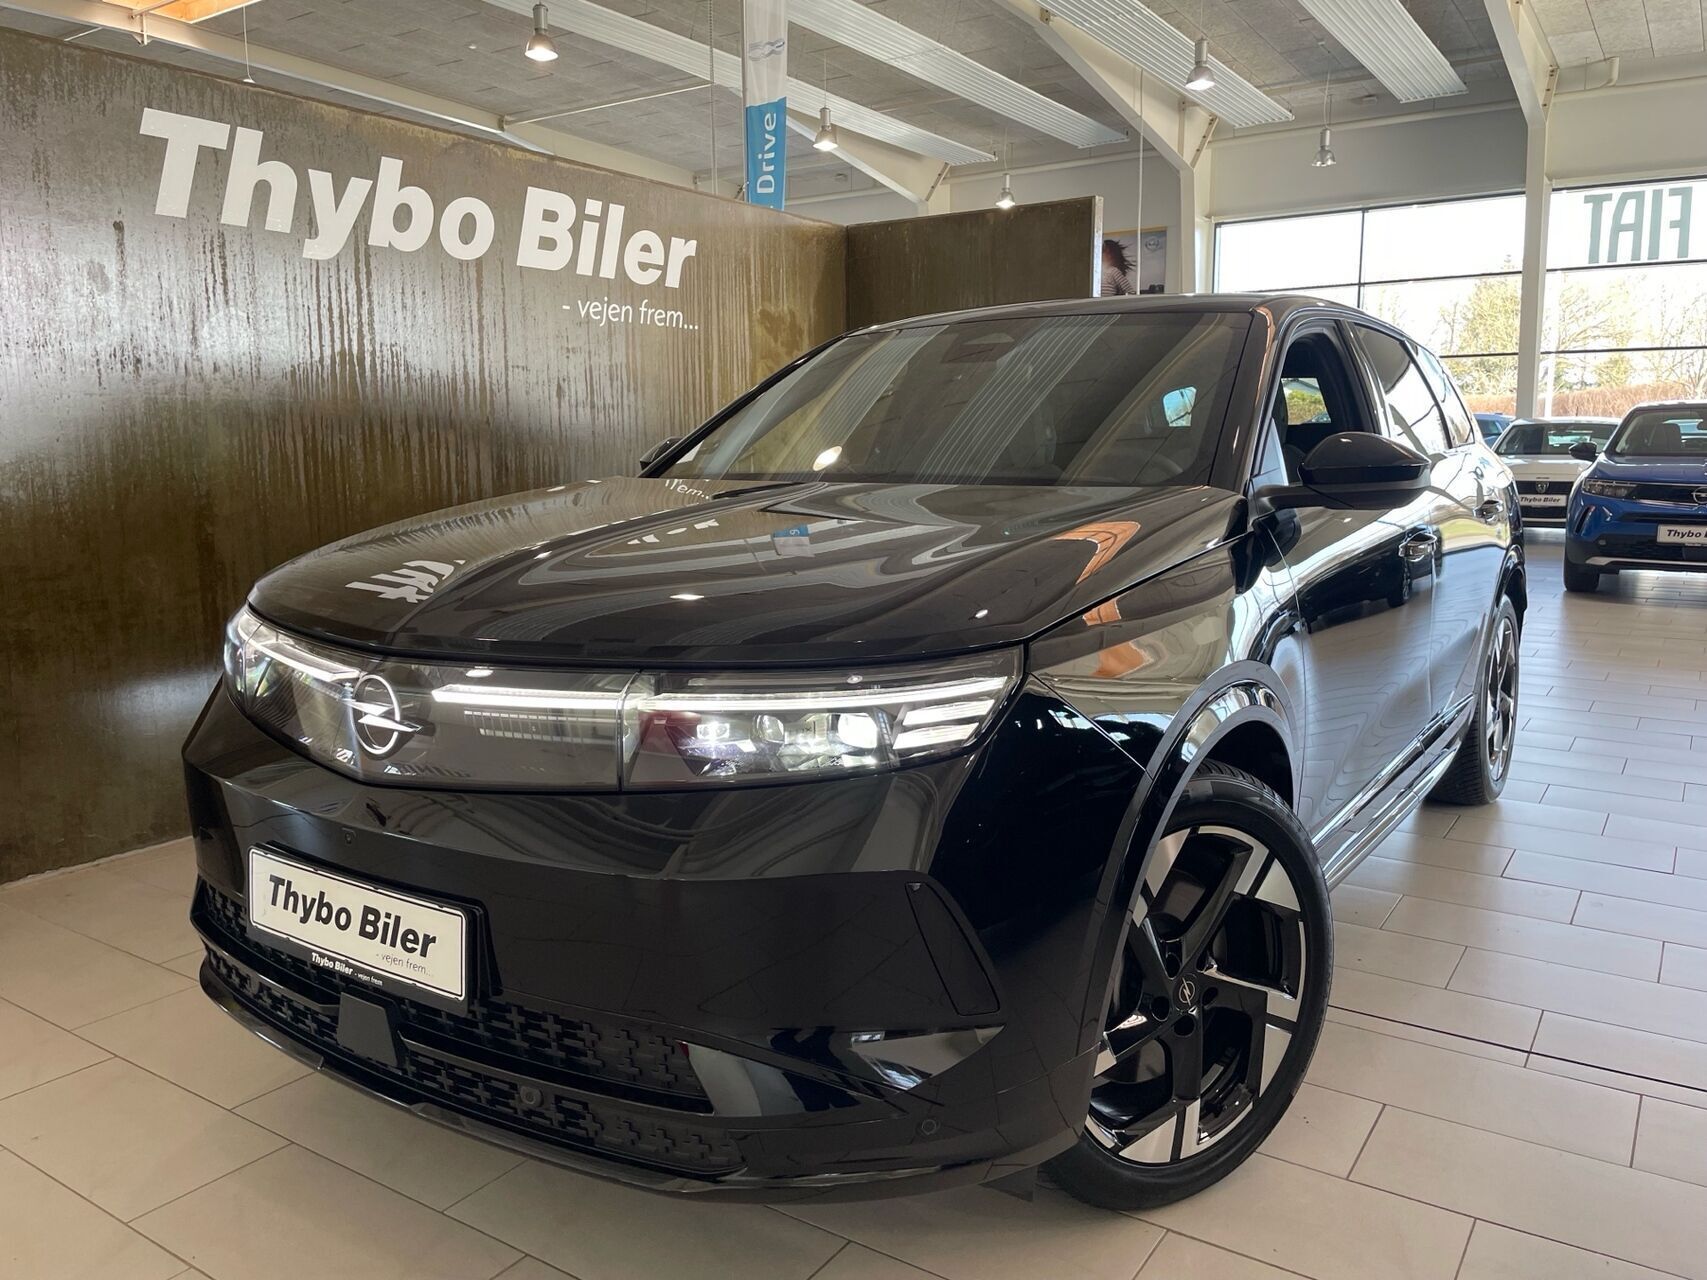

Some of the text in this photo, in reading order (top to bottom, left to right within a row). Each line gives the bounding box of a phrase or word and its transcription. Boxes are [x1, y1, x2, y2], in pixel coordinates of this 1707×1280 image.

[756, 111, 778, 194] Drive
[139, 107, 697, 289] Thybo Biler
[577, 296, 633, 327] vejen
[639, 299, 699, 330] frem...
[1519, 496, 1543, 504] Thybo
[1666, 529, 1702, 539] Thybo
[269, 874, 437, 958] Thybo Biler
[311, 952, 334, 967] Thybo
[334, 960, 354, 975] Biler
[381, 953, 404, 967] vejen
